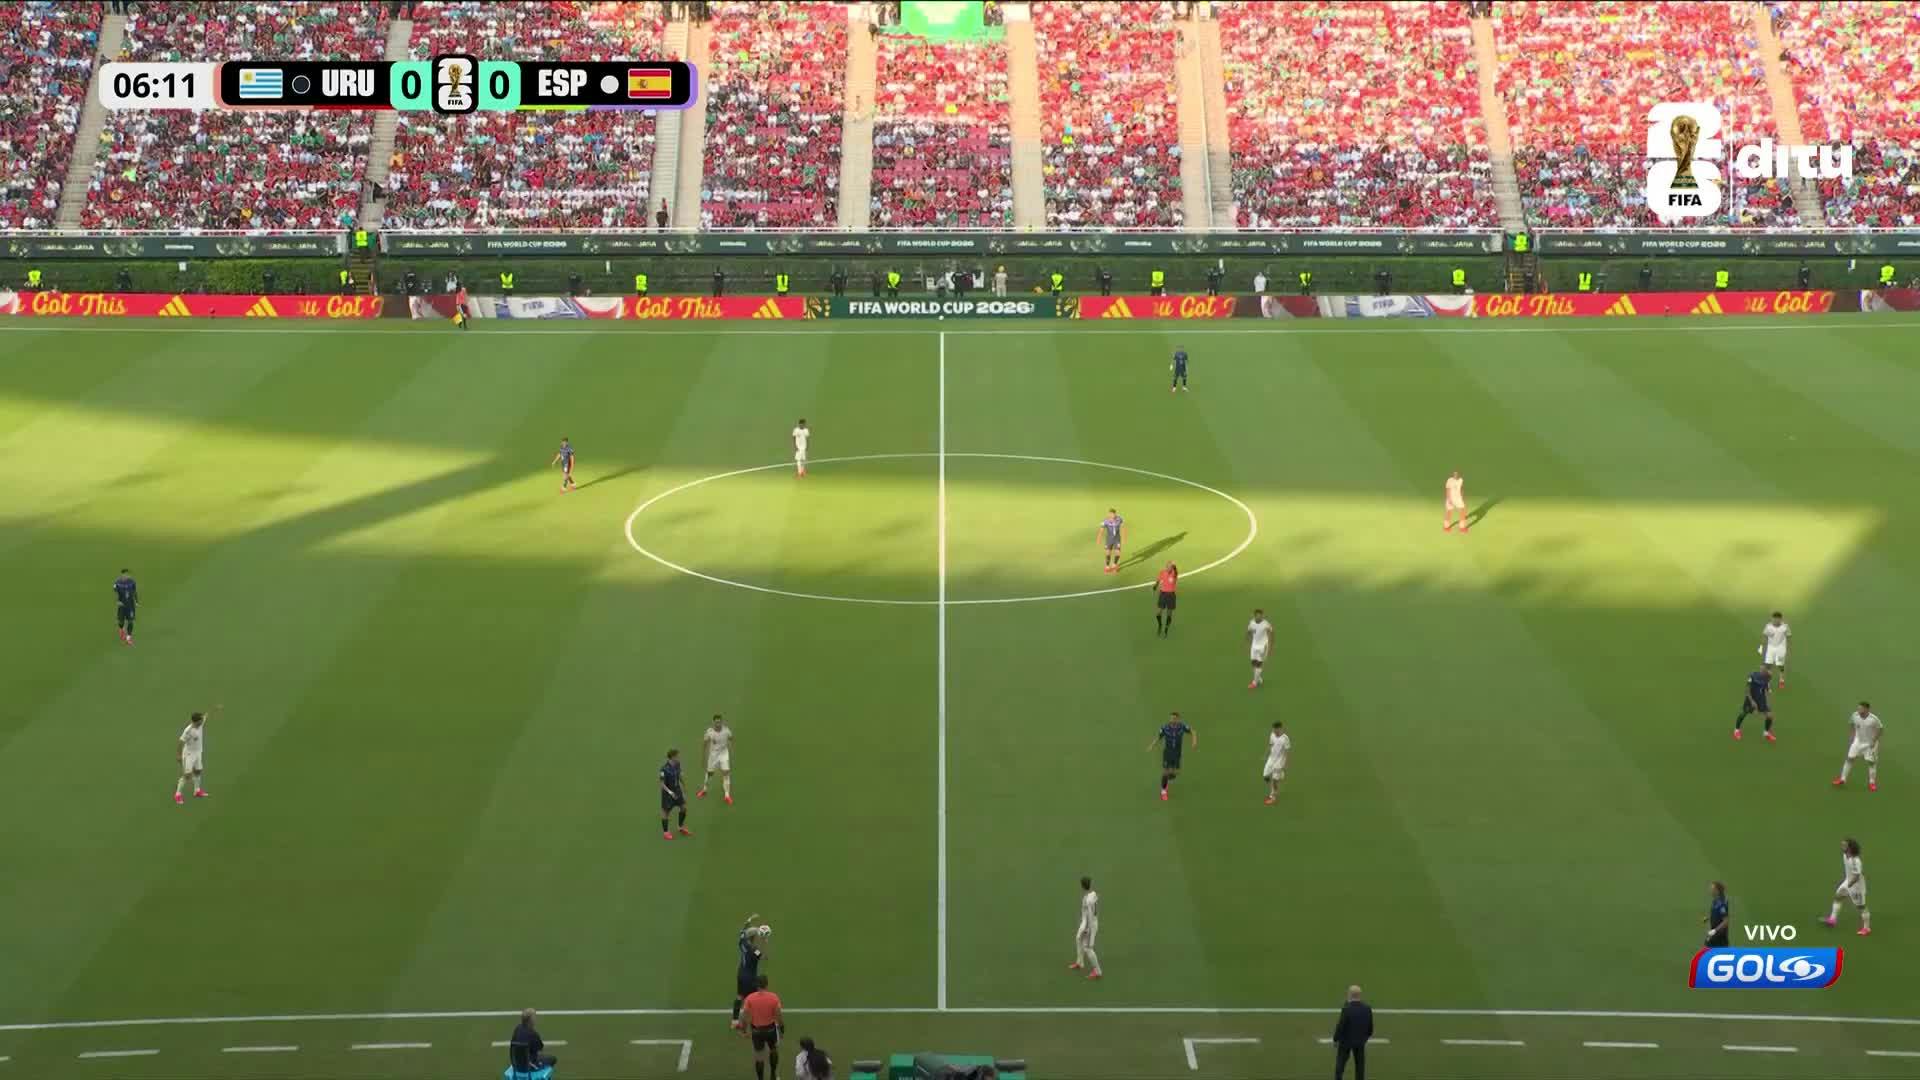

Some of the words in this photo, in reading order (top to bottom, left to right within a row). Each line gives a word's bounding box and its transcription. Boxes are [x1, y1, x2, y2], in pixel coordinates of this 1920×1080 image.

[32, 291, 72, 315] Got
[79, 292, 126, 316] This
[327, 294, 363, 318] Got
[636, 296, 672, 319] Got
[678, 296, 722, 320] This
[849, 301, 882, 314] FIFA
[884, 301, 941, 314] WORLD
[942, 301, 975, 314] CUP
[975, 301, 1031, 314] 2026
[1179, 295, 1216, 318] Got
[1486, 293, 1524, 317] Got
[1529, 293, 1576, 317] This
[1774, 291, 1814, 314] Got
